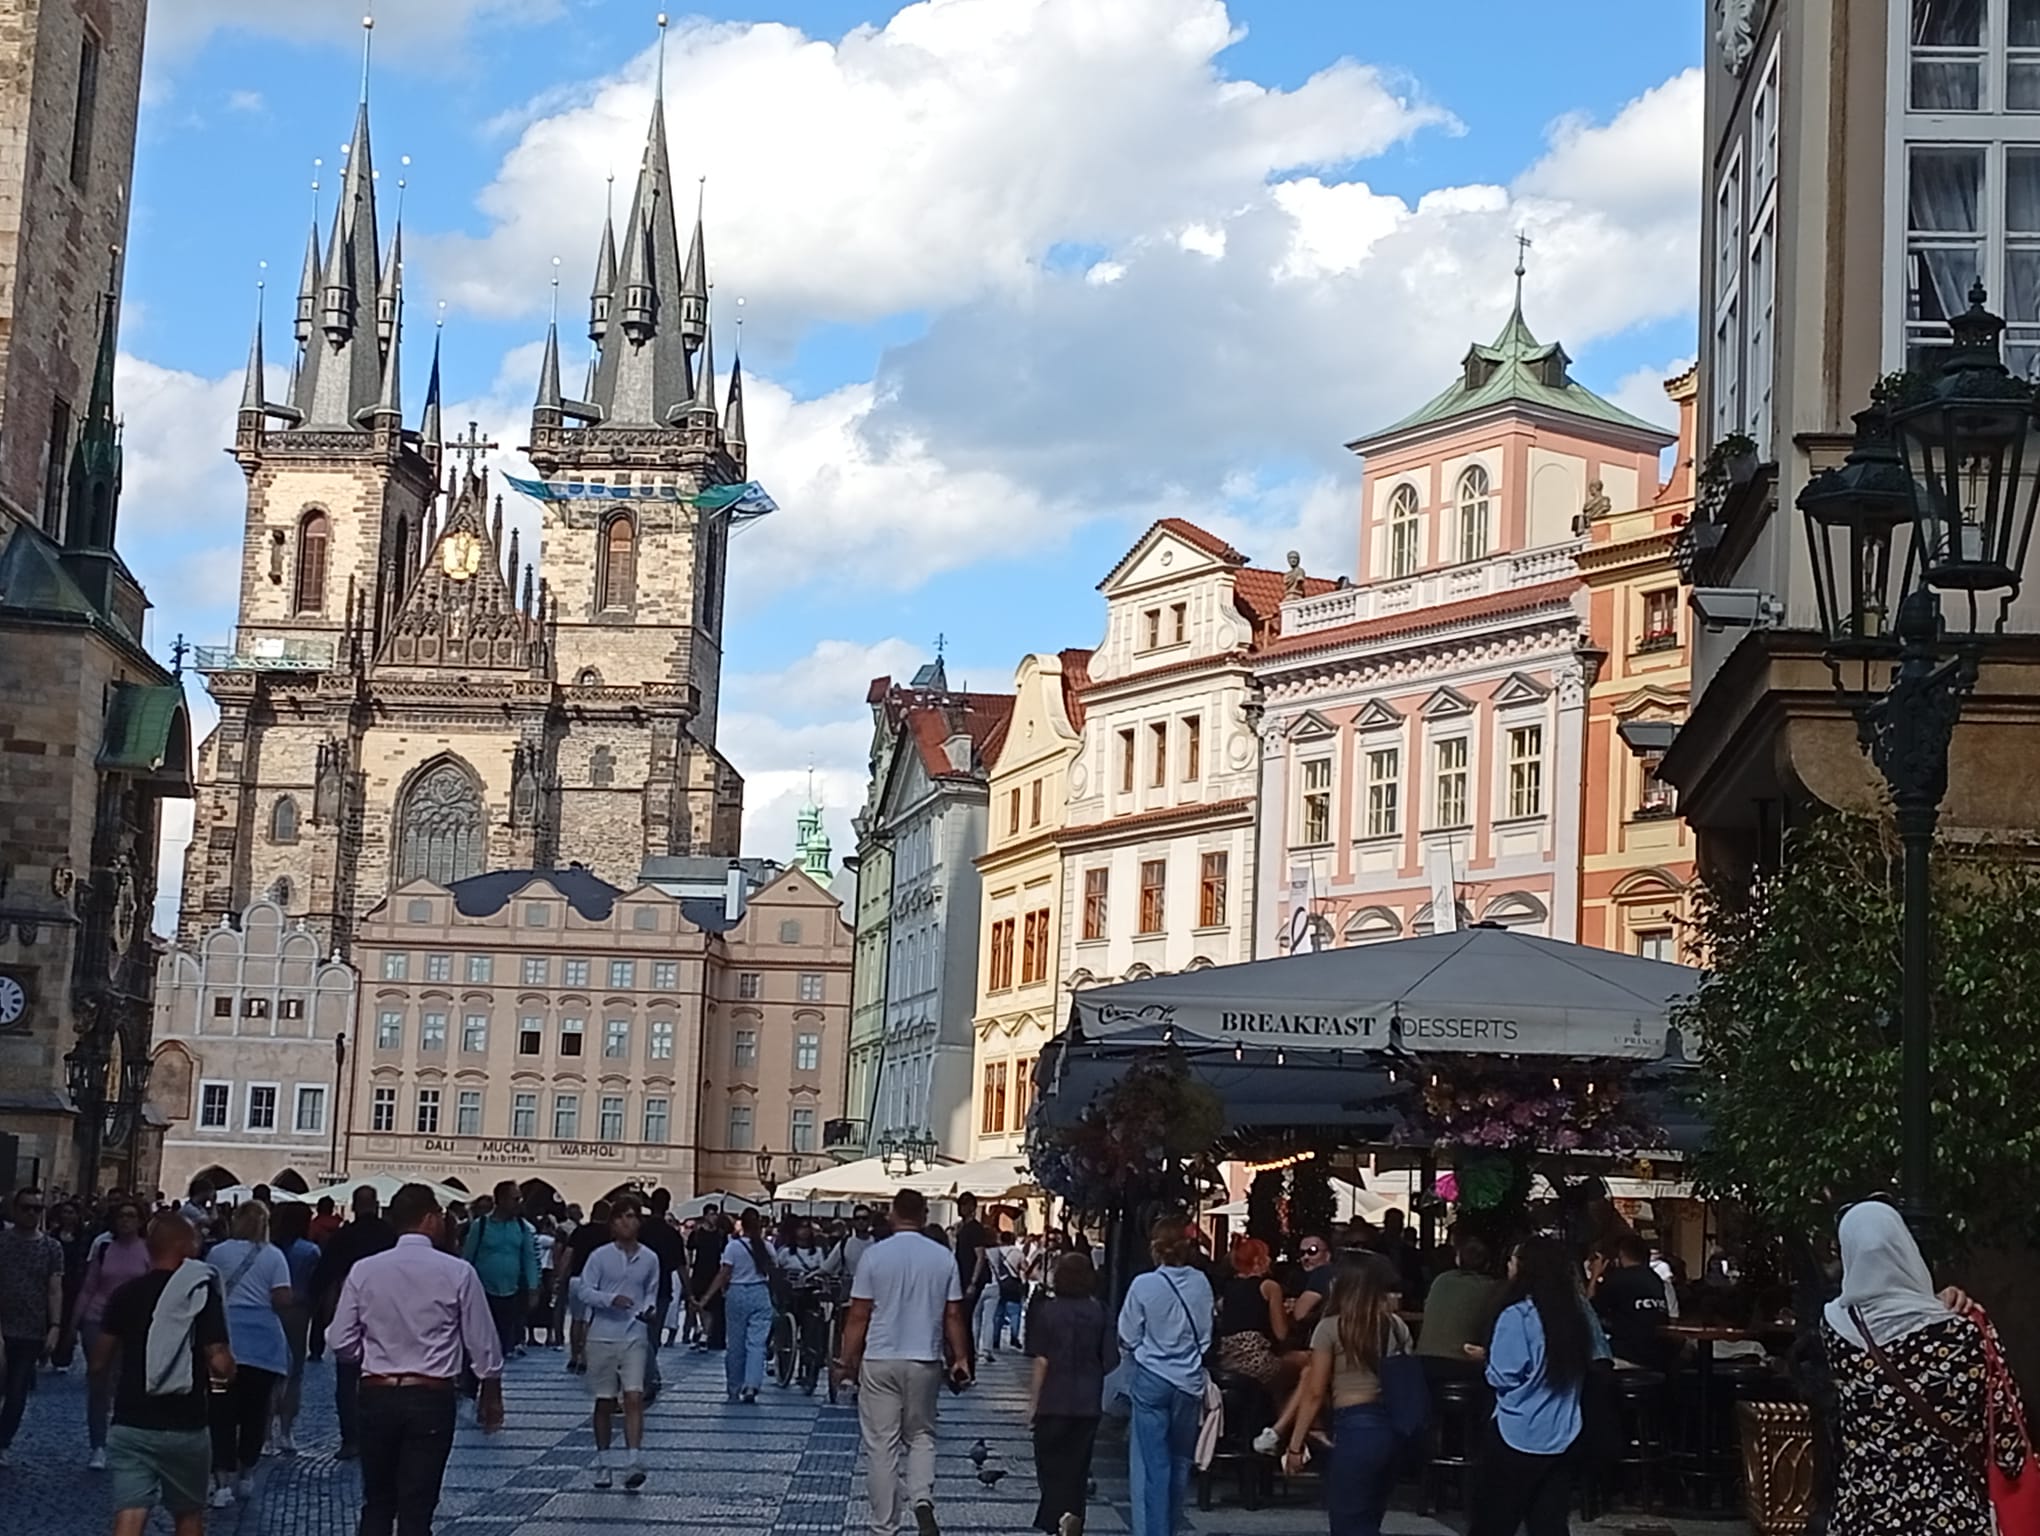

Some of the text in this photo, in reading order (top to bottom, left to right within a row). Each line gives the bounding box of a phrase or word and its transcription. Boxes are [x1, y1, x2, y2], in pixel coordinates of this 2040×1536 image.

[1221, 1011, 1376, 1037] BREAKFAST
[1402, 1018, 1518, 1040] DESSERTS
[425, 1139, 455, 1152] DALI
[483, 1141, 531, 1155] MUCHA
[559, 1144, 616, 1157] WARHOL
[477, 1153, 536, 1163] exhibition
[363, 1164, 422, 1173] RESTAURANT
